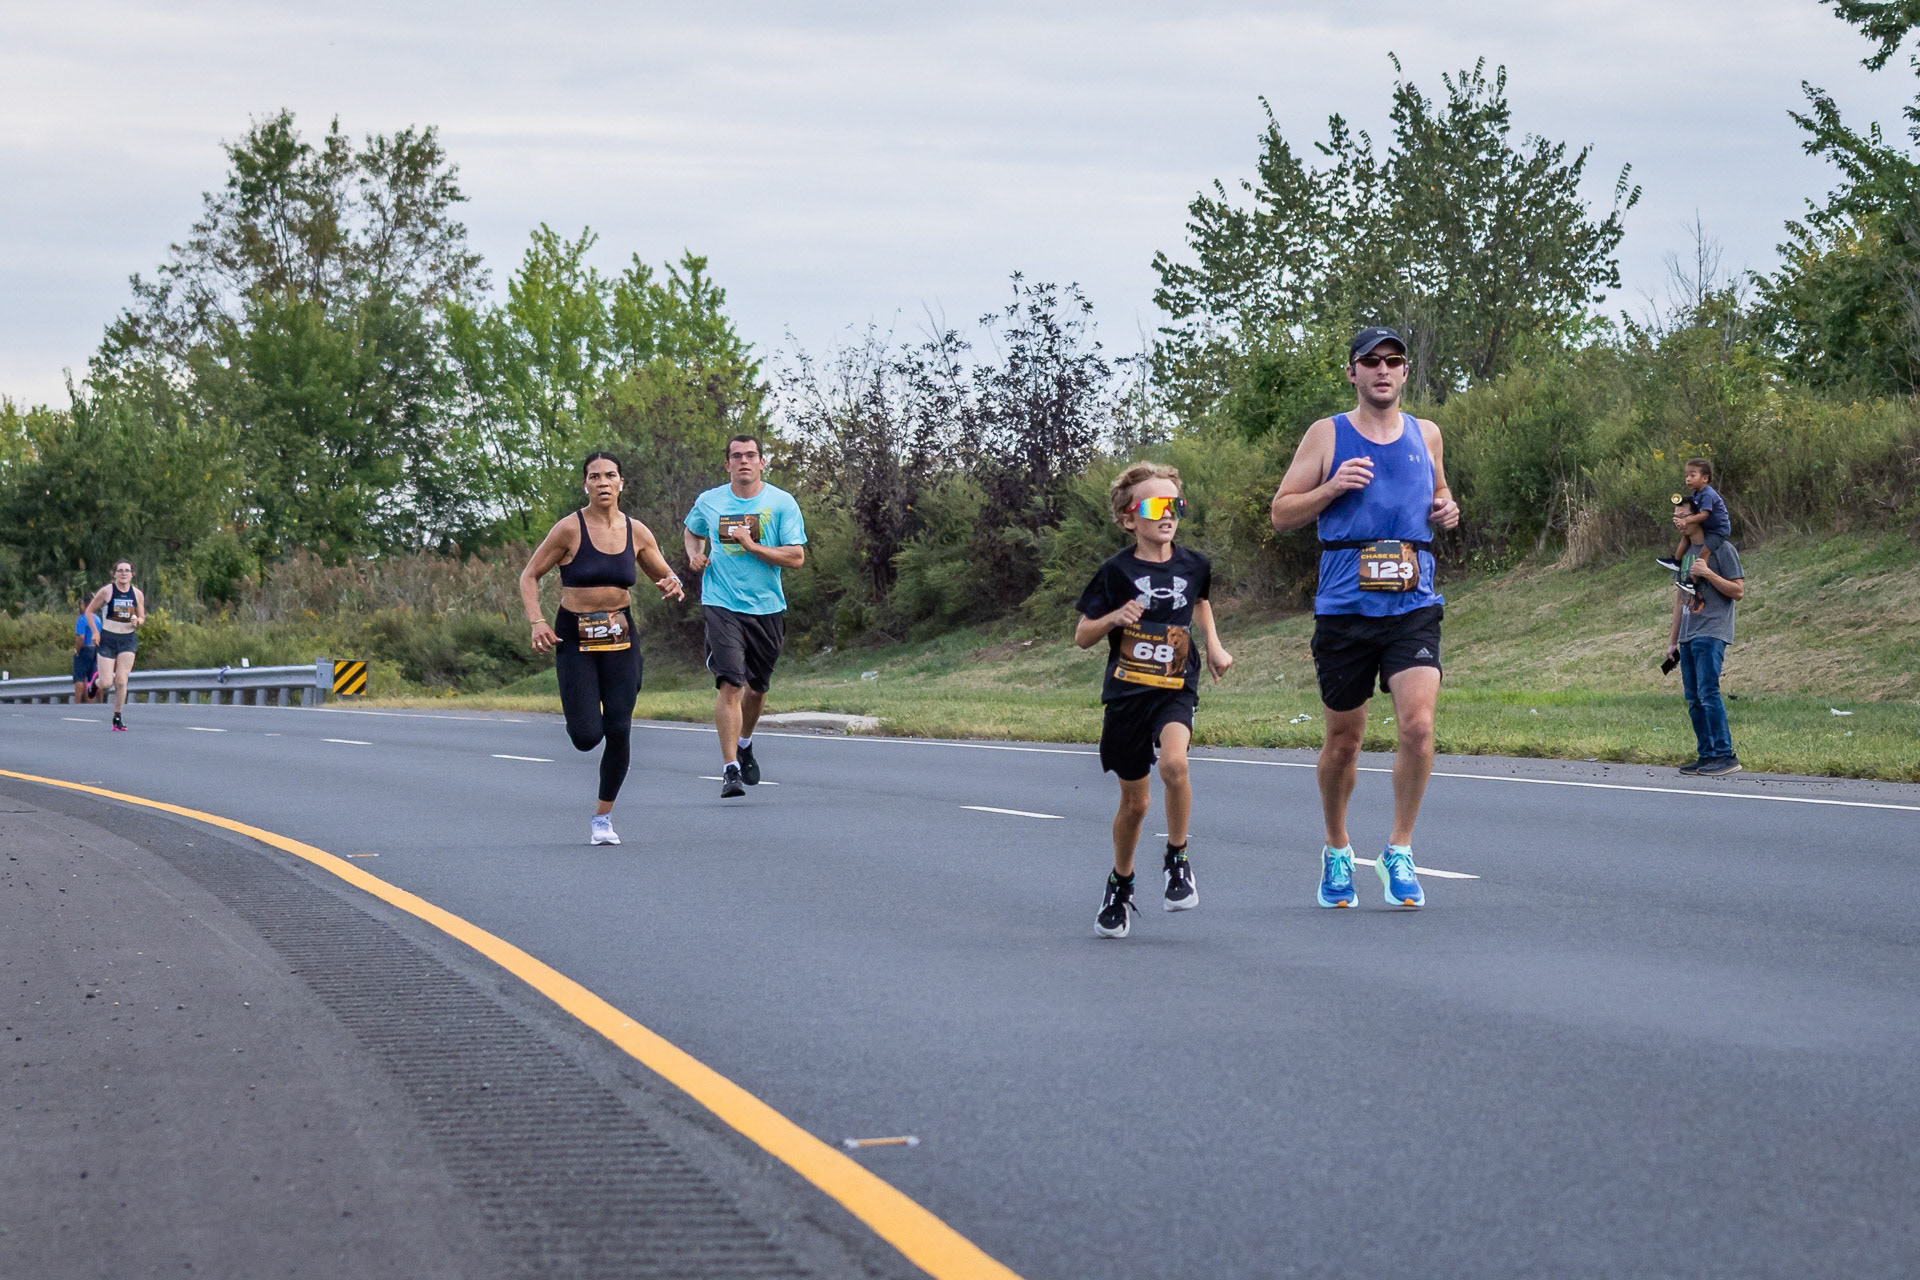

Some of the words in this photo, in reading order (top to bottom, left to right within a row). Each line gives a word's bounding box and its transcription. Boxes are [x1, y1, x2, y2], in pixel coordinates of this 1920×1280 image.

[1368, 561, 1413, 579] 123
[585, 624, 622, 638] 124
[1123, 629, 1152, 640] CHASE
[1133, 642, 1174, 663] 68
